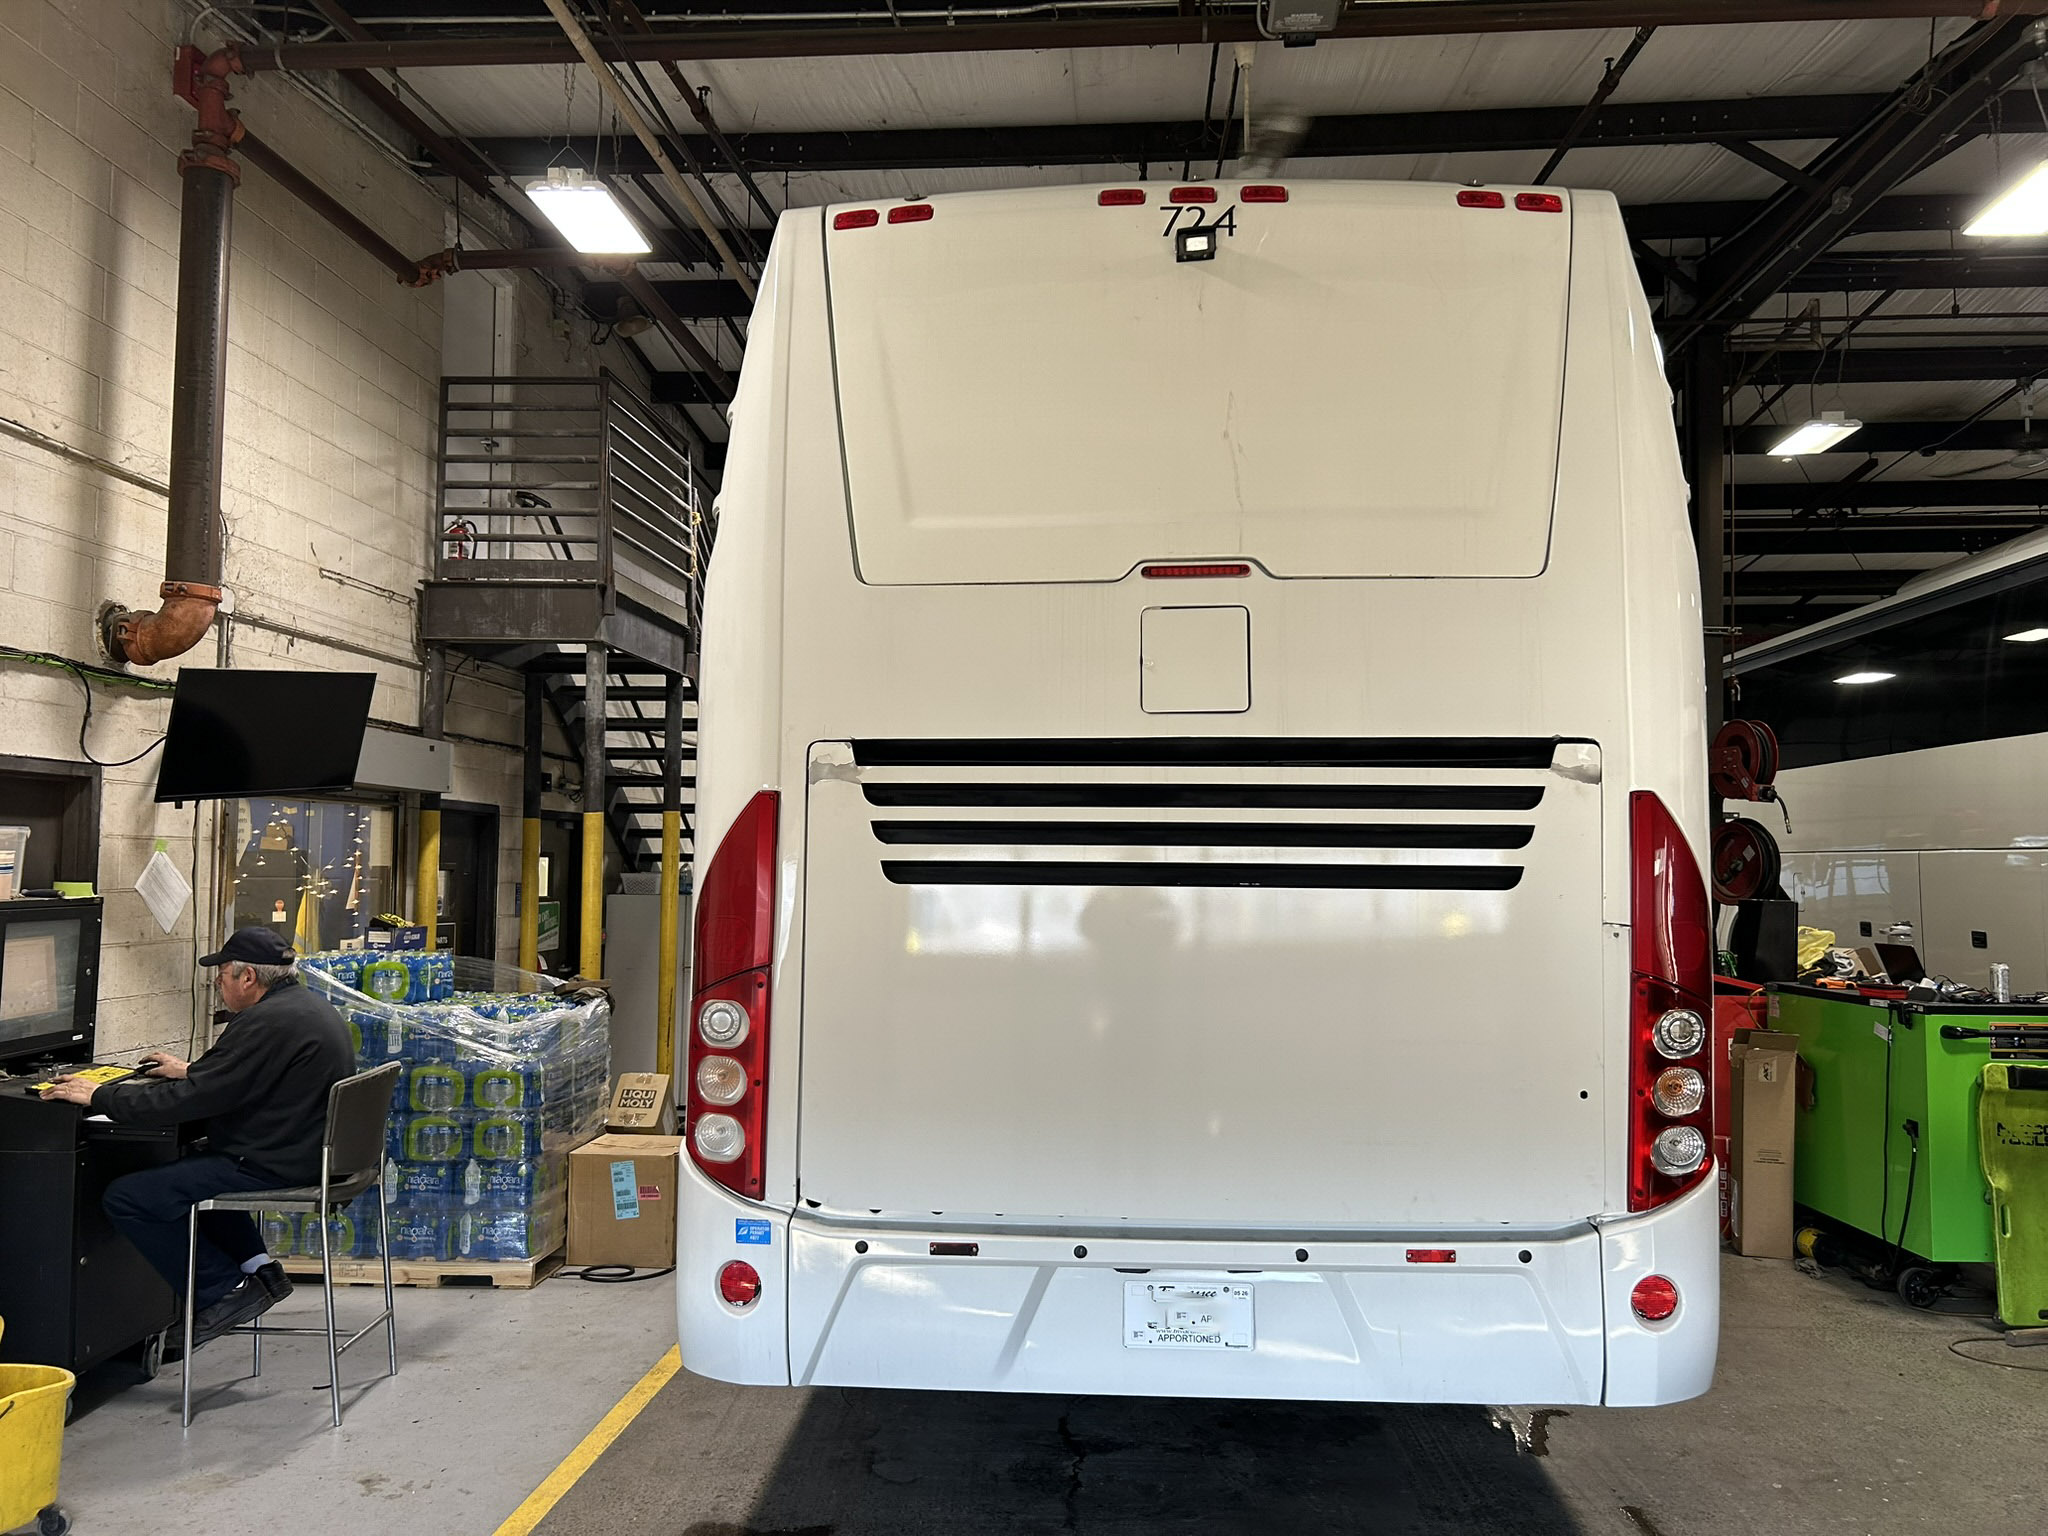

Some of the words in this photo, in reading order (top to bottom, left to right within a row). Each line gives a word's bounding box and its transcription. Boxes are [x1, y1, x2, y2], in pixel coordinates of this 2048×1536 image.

[1160, 204, 1238, 237] 724
[622, 1090, 655, 1099] LIQUI
[619, 1099, 653, 1108] MOLY
[407, 1175, 440, 1188] niagara
[489, 1176, 520, 1189] niagara
[1719, 1161, 1728, 1200] FUEL
[1157, 1334, 1221, 1344] APPORTIONED
